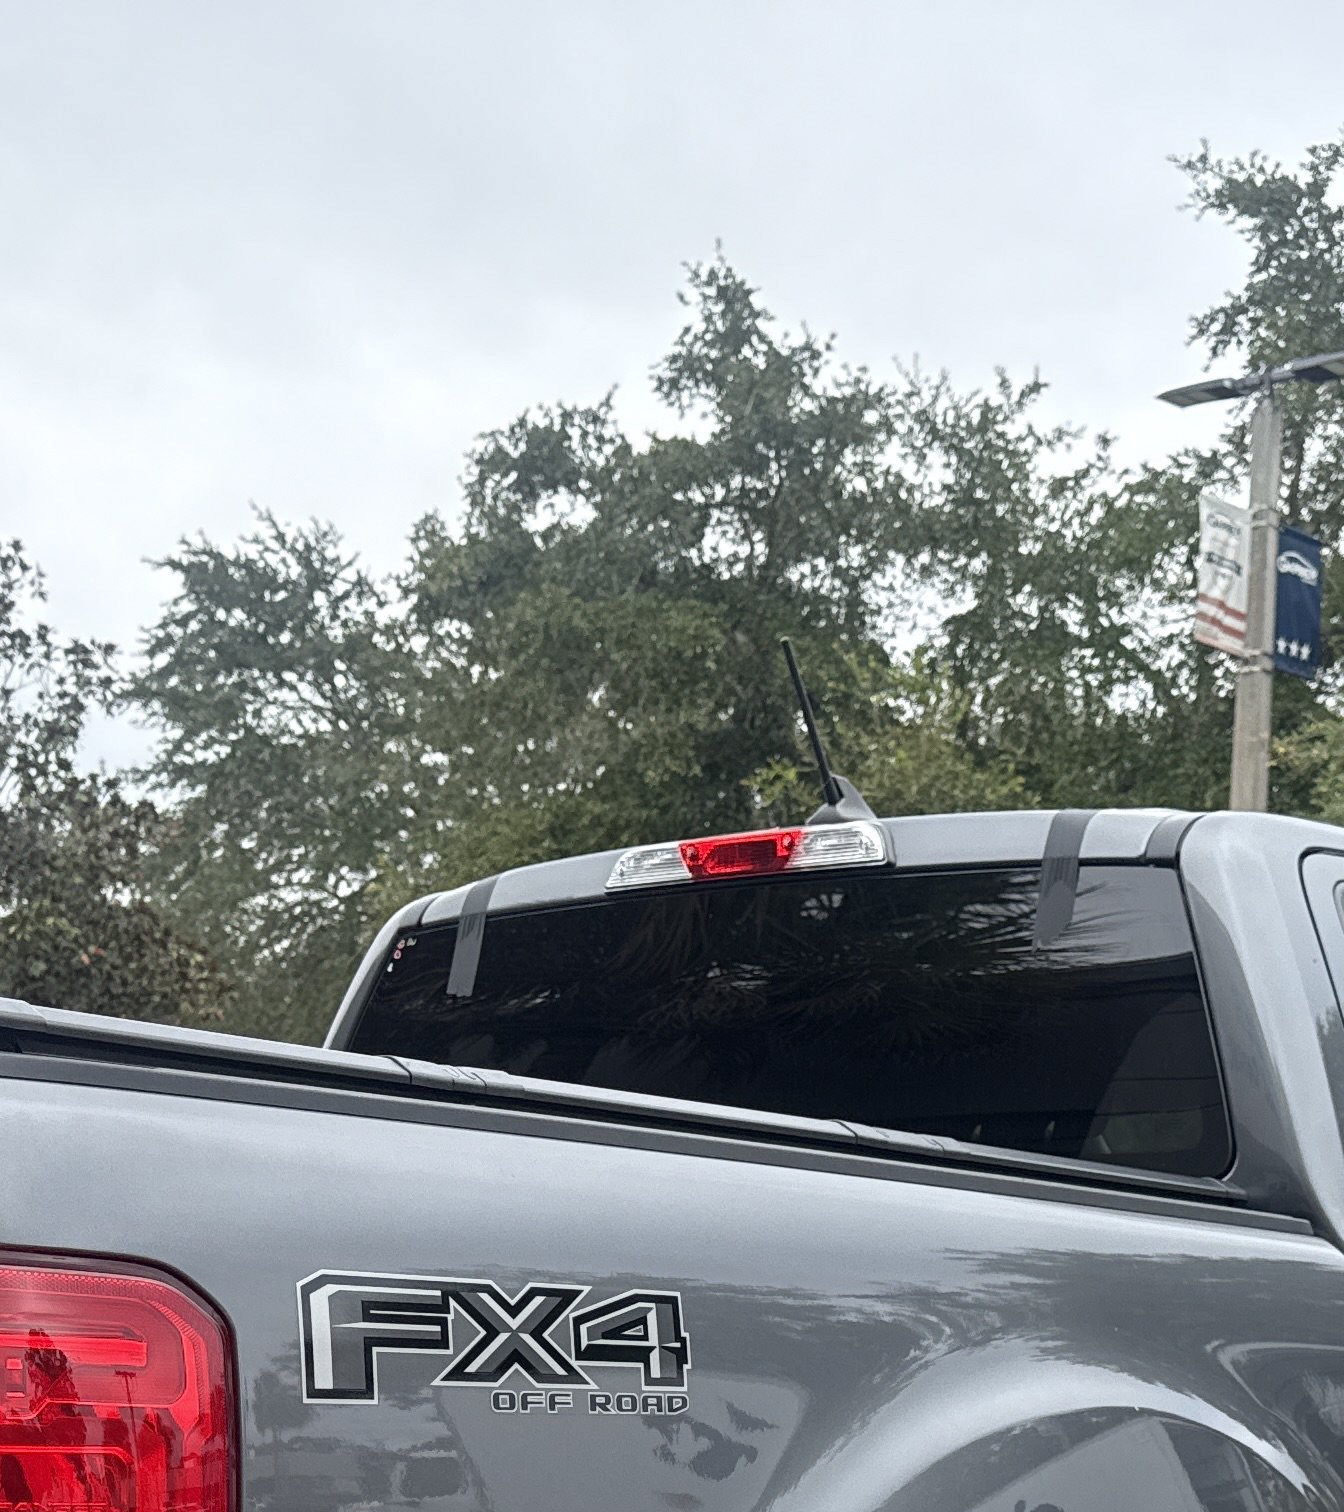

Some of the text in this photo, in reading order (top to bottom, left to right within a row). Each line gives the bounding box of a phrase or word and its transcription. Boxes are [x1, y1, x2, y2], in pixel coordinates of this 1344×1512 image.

[296, 1268, 692, 1405] FX4
[491, 1389, 690, 1415] OFF ROAD
